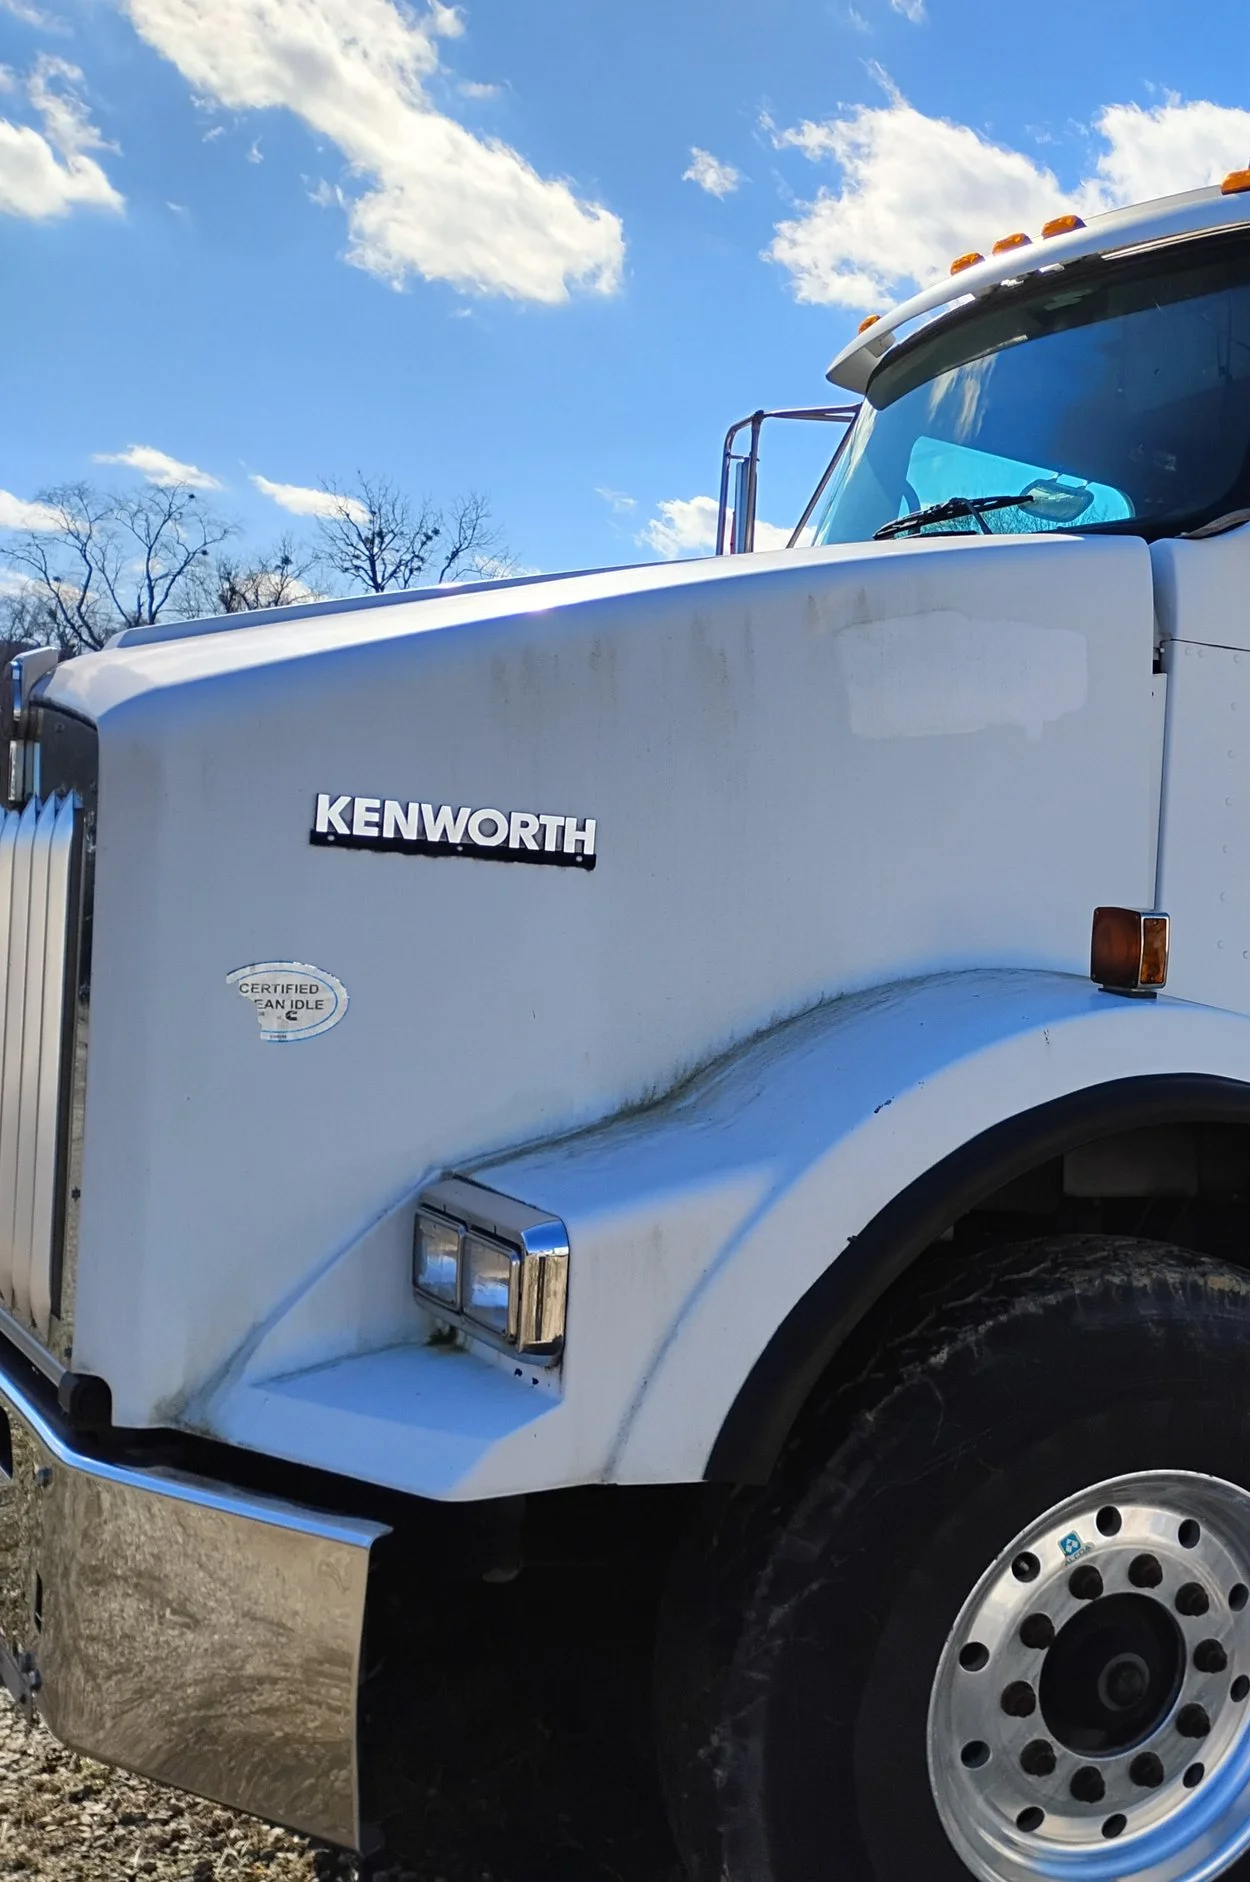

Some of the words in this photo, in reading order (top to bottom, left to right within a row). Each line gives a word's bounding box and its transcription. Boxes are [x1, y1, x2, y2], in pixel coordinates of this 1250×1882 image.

[315, 793, 597, 854] KENWORTH
[239, 983, 319, 994] CERTIFIED
[290, 999, 324, 1010] IDLE
